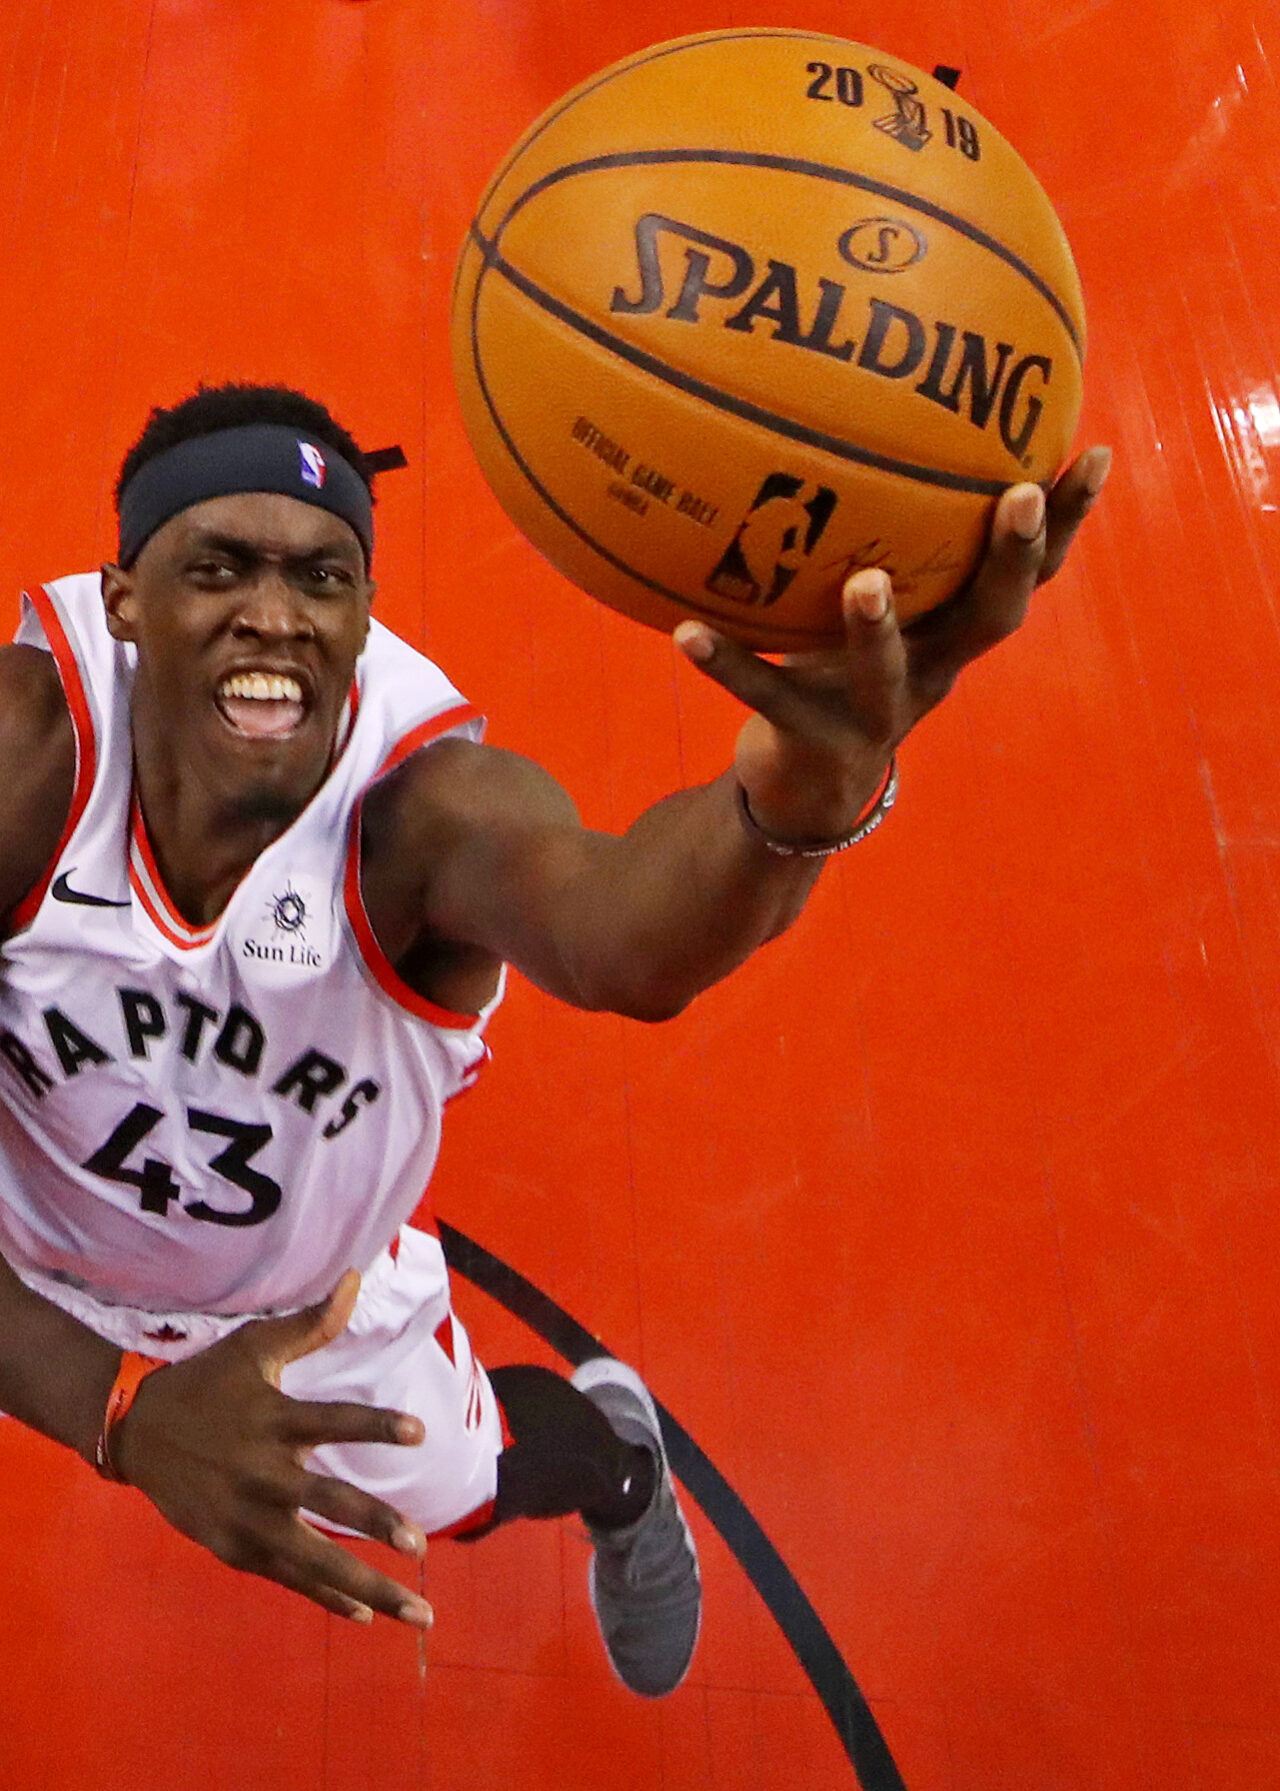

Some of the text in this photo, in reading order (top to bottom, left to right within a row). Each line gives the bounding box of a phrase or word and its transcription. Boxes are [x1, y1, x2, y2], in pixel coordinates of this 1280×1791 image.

[806, 62, 981, 162] 20 19
[867, 226, 900, 264] S
[609, 212, 1052, 463] SPALDING
[572, 415, 630, 475] OFFICIAL
[631, 464, 676, 504] GAME
[676, 492, 719, 527] BALL
[243, 938, 322, 968] Sun Life
[82, 1102, 282, 1228] 43
